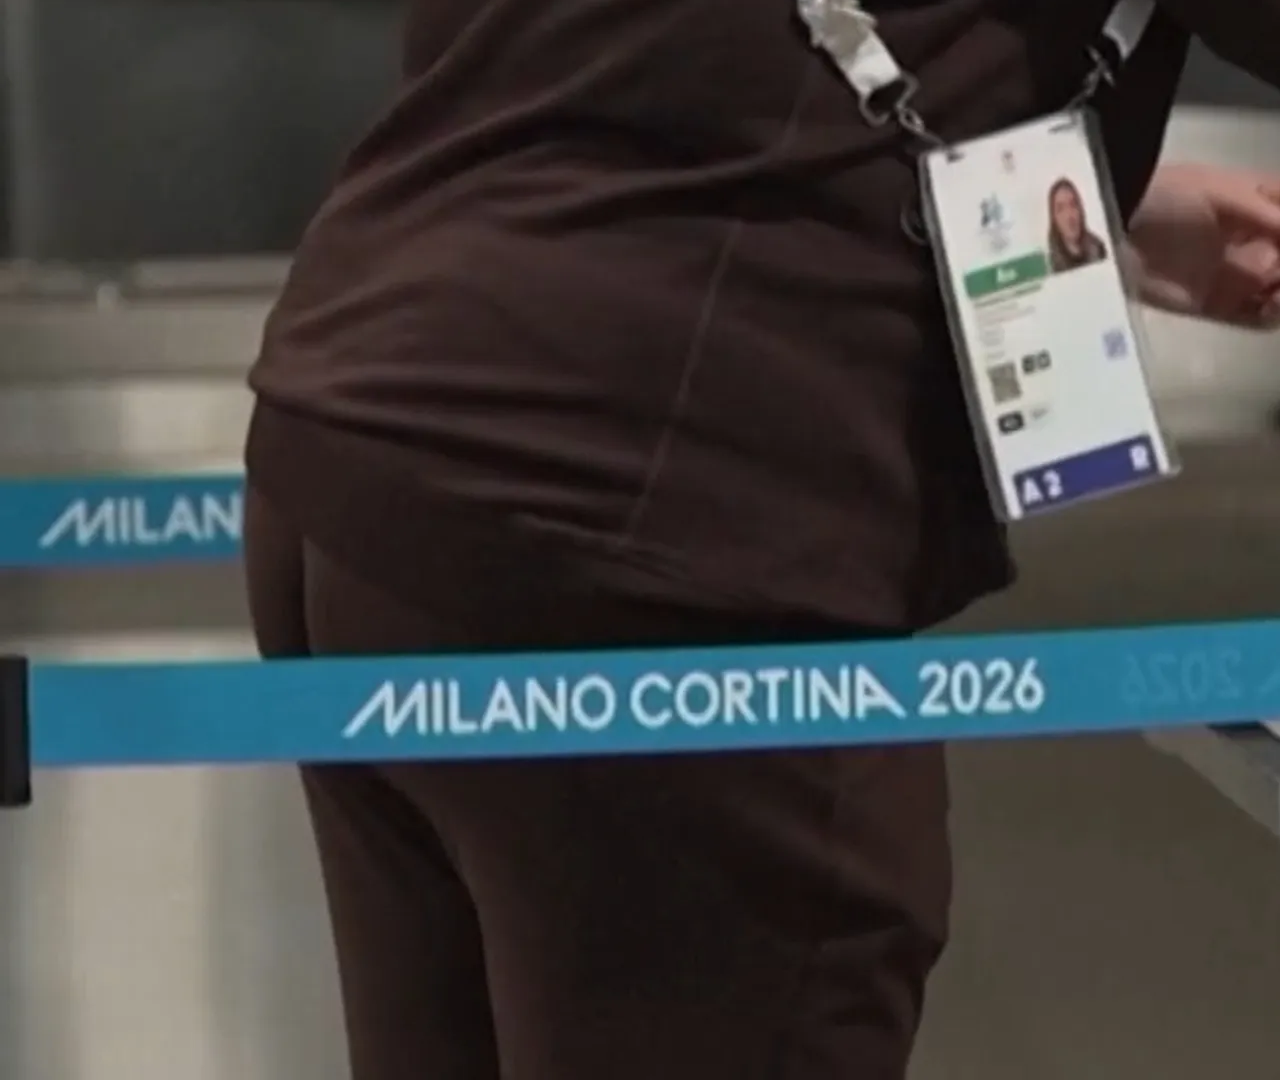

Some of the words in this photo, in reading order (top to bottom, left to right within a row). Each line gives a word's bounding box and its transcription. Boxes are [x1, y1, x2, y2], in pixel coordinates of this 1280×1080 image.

[341, 672, 617, 739] MILANO
[629, 663, 908, 729] CORTINA
[917, 657, 1046, 718] 2026
